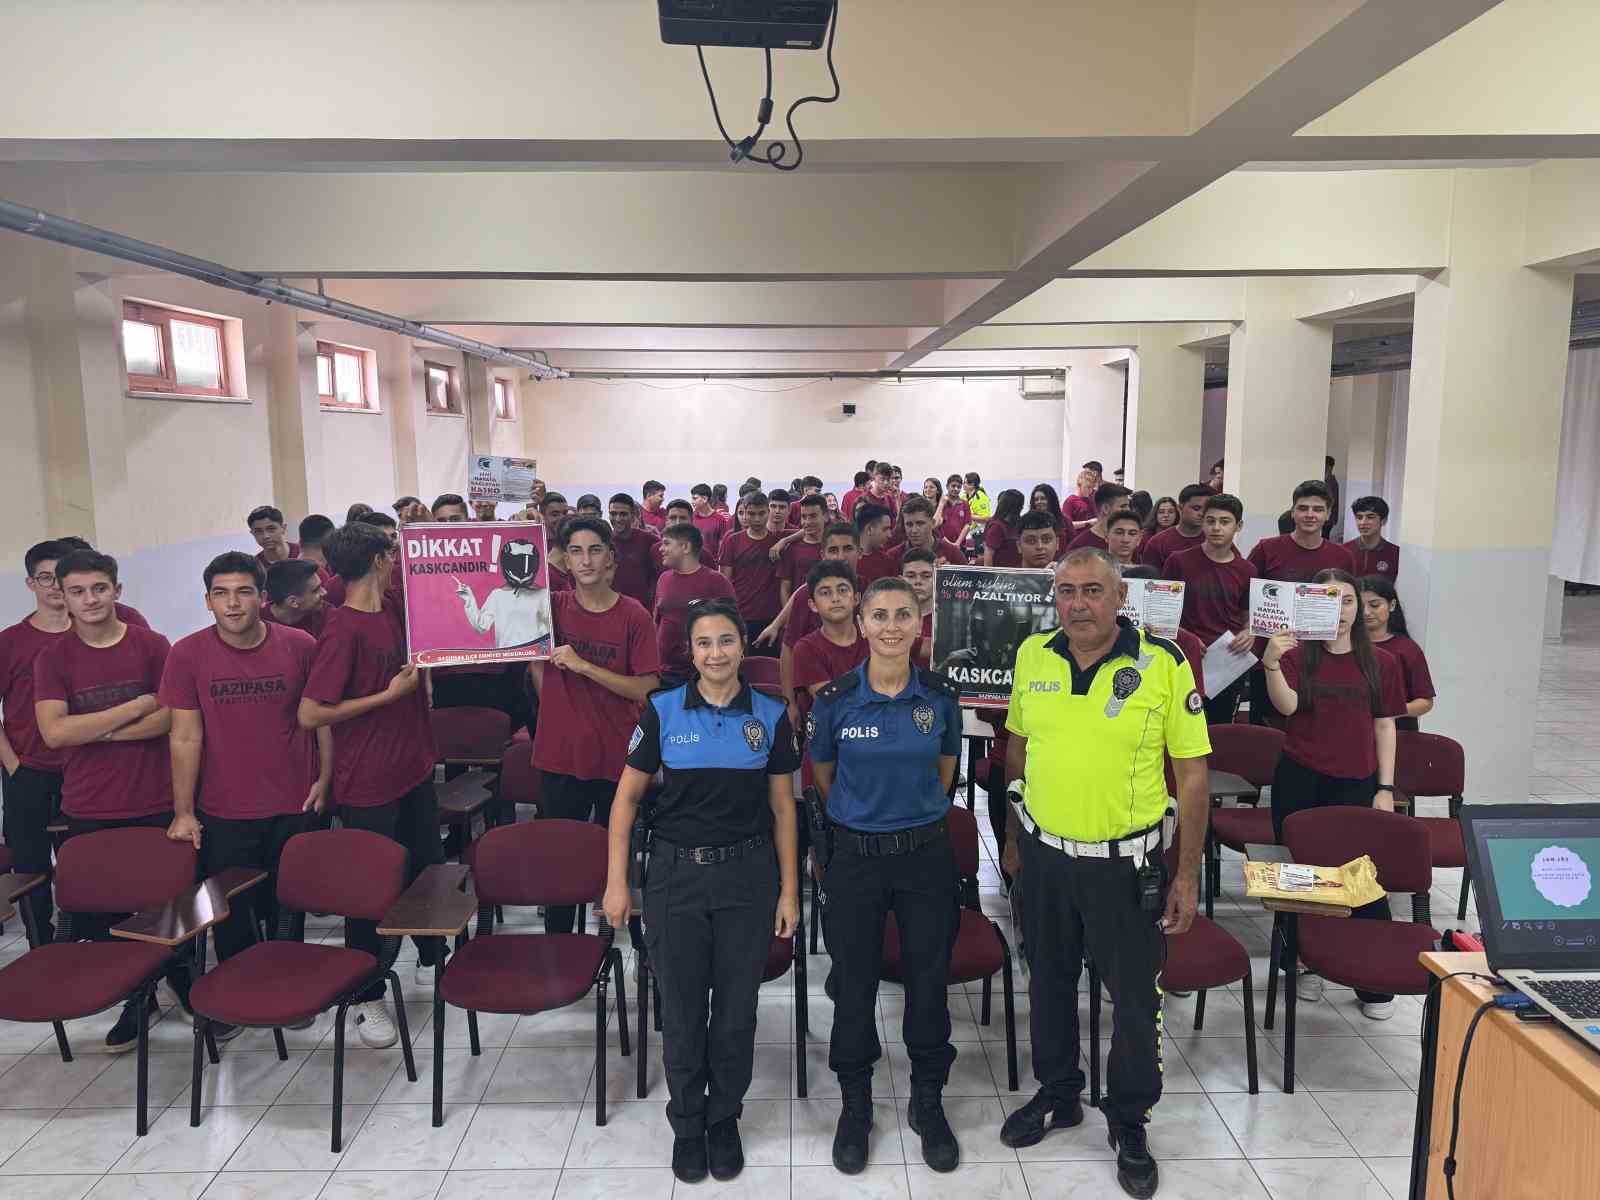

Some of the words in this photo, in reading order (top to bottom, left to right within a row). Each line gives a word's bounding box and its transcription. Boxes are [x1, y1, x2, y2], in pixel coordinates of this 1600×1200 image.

[407, 534, 483, 559] DİKKAT
[972, 591, 1041, 603] AZALTIYOR
[947, 666, 1014, 685] KASKCA
